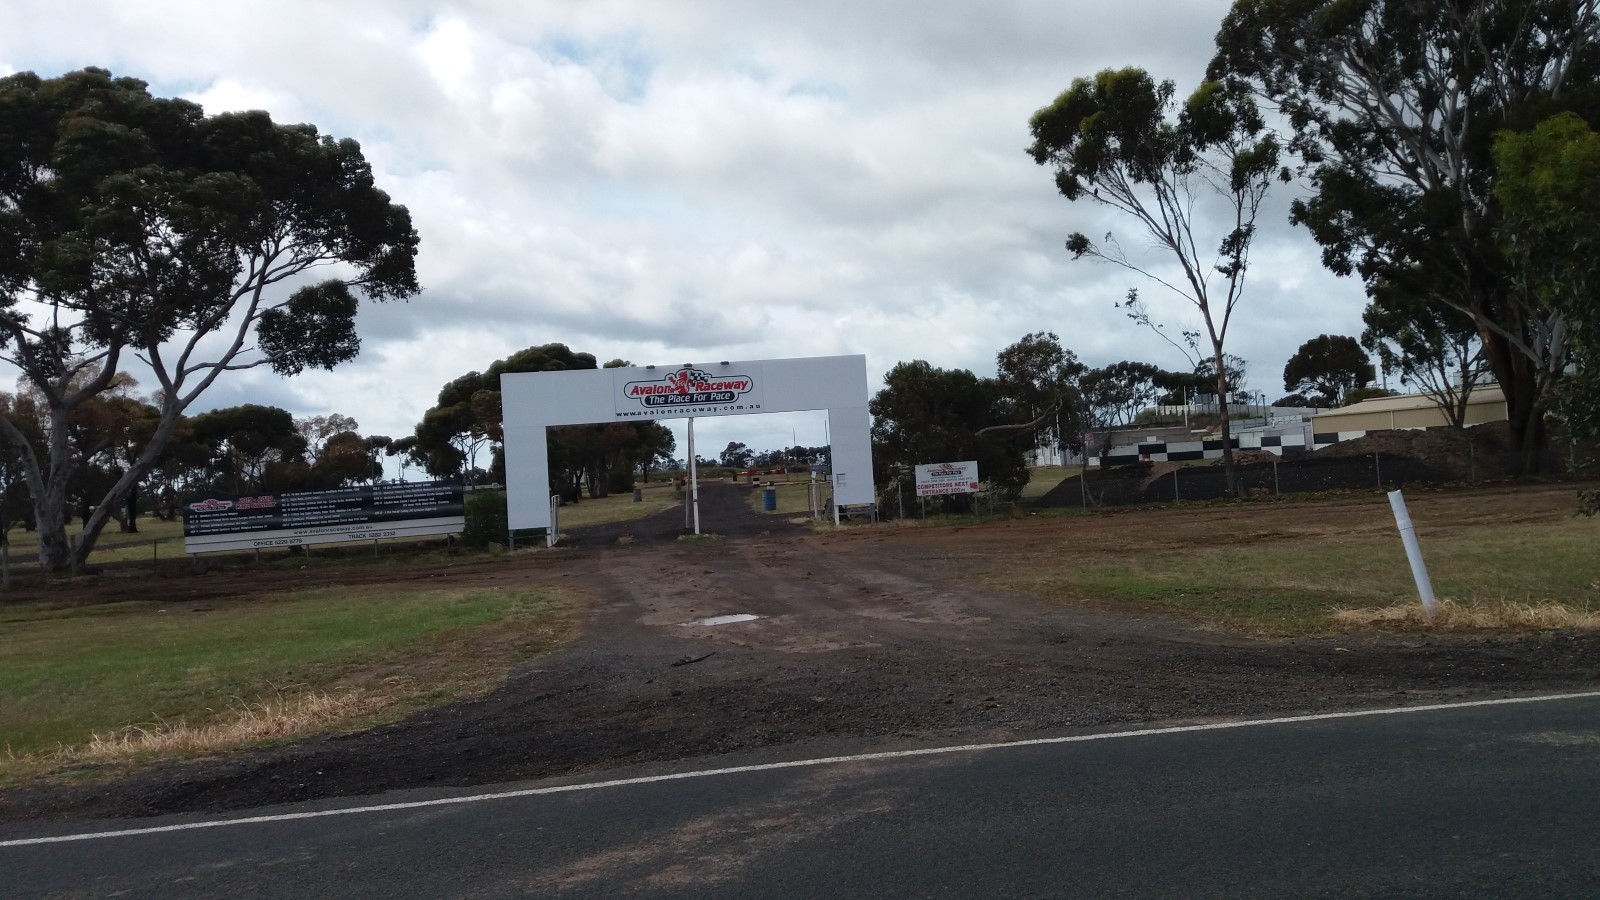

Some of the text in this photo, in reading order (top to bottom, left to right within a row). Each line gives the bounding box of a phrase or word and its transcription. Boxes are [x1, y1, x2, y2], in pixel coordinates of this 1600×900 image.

[630, 380, 749, 396] Avalon Raceway
[649, 392, 731, 404] The Place For Pace
[616, 404, 761, 417] www.avalonraceway.com.au
[917, 482, 953, 490] COMPETITORS
